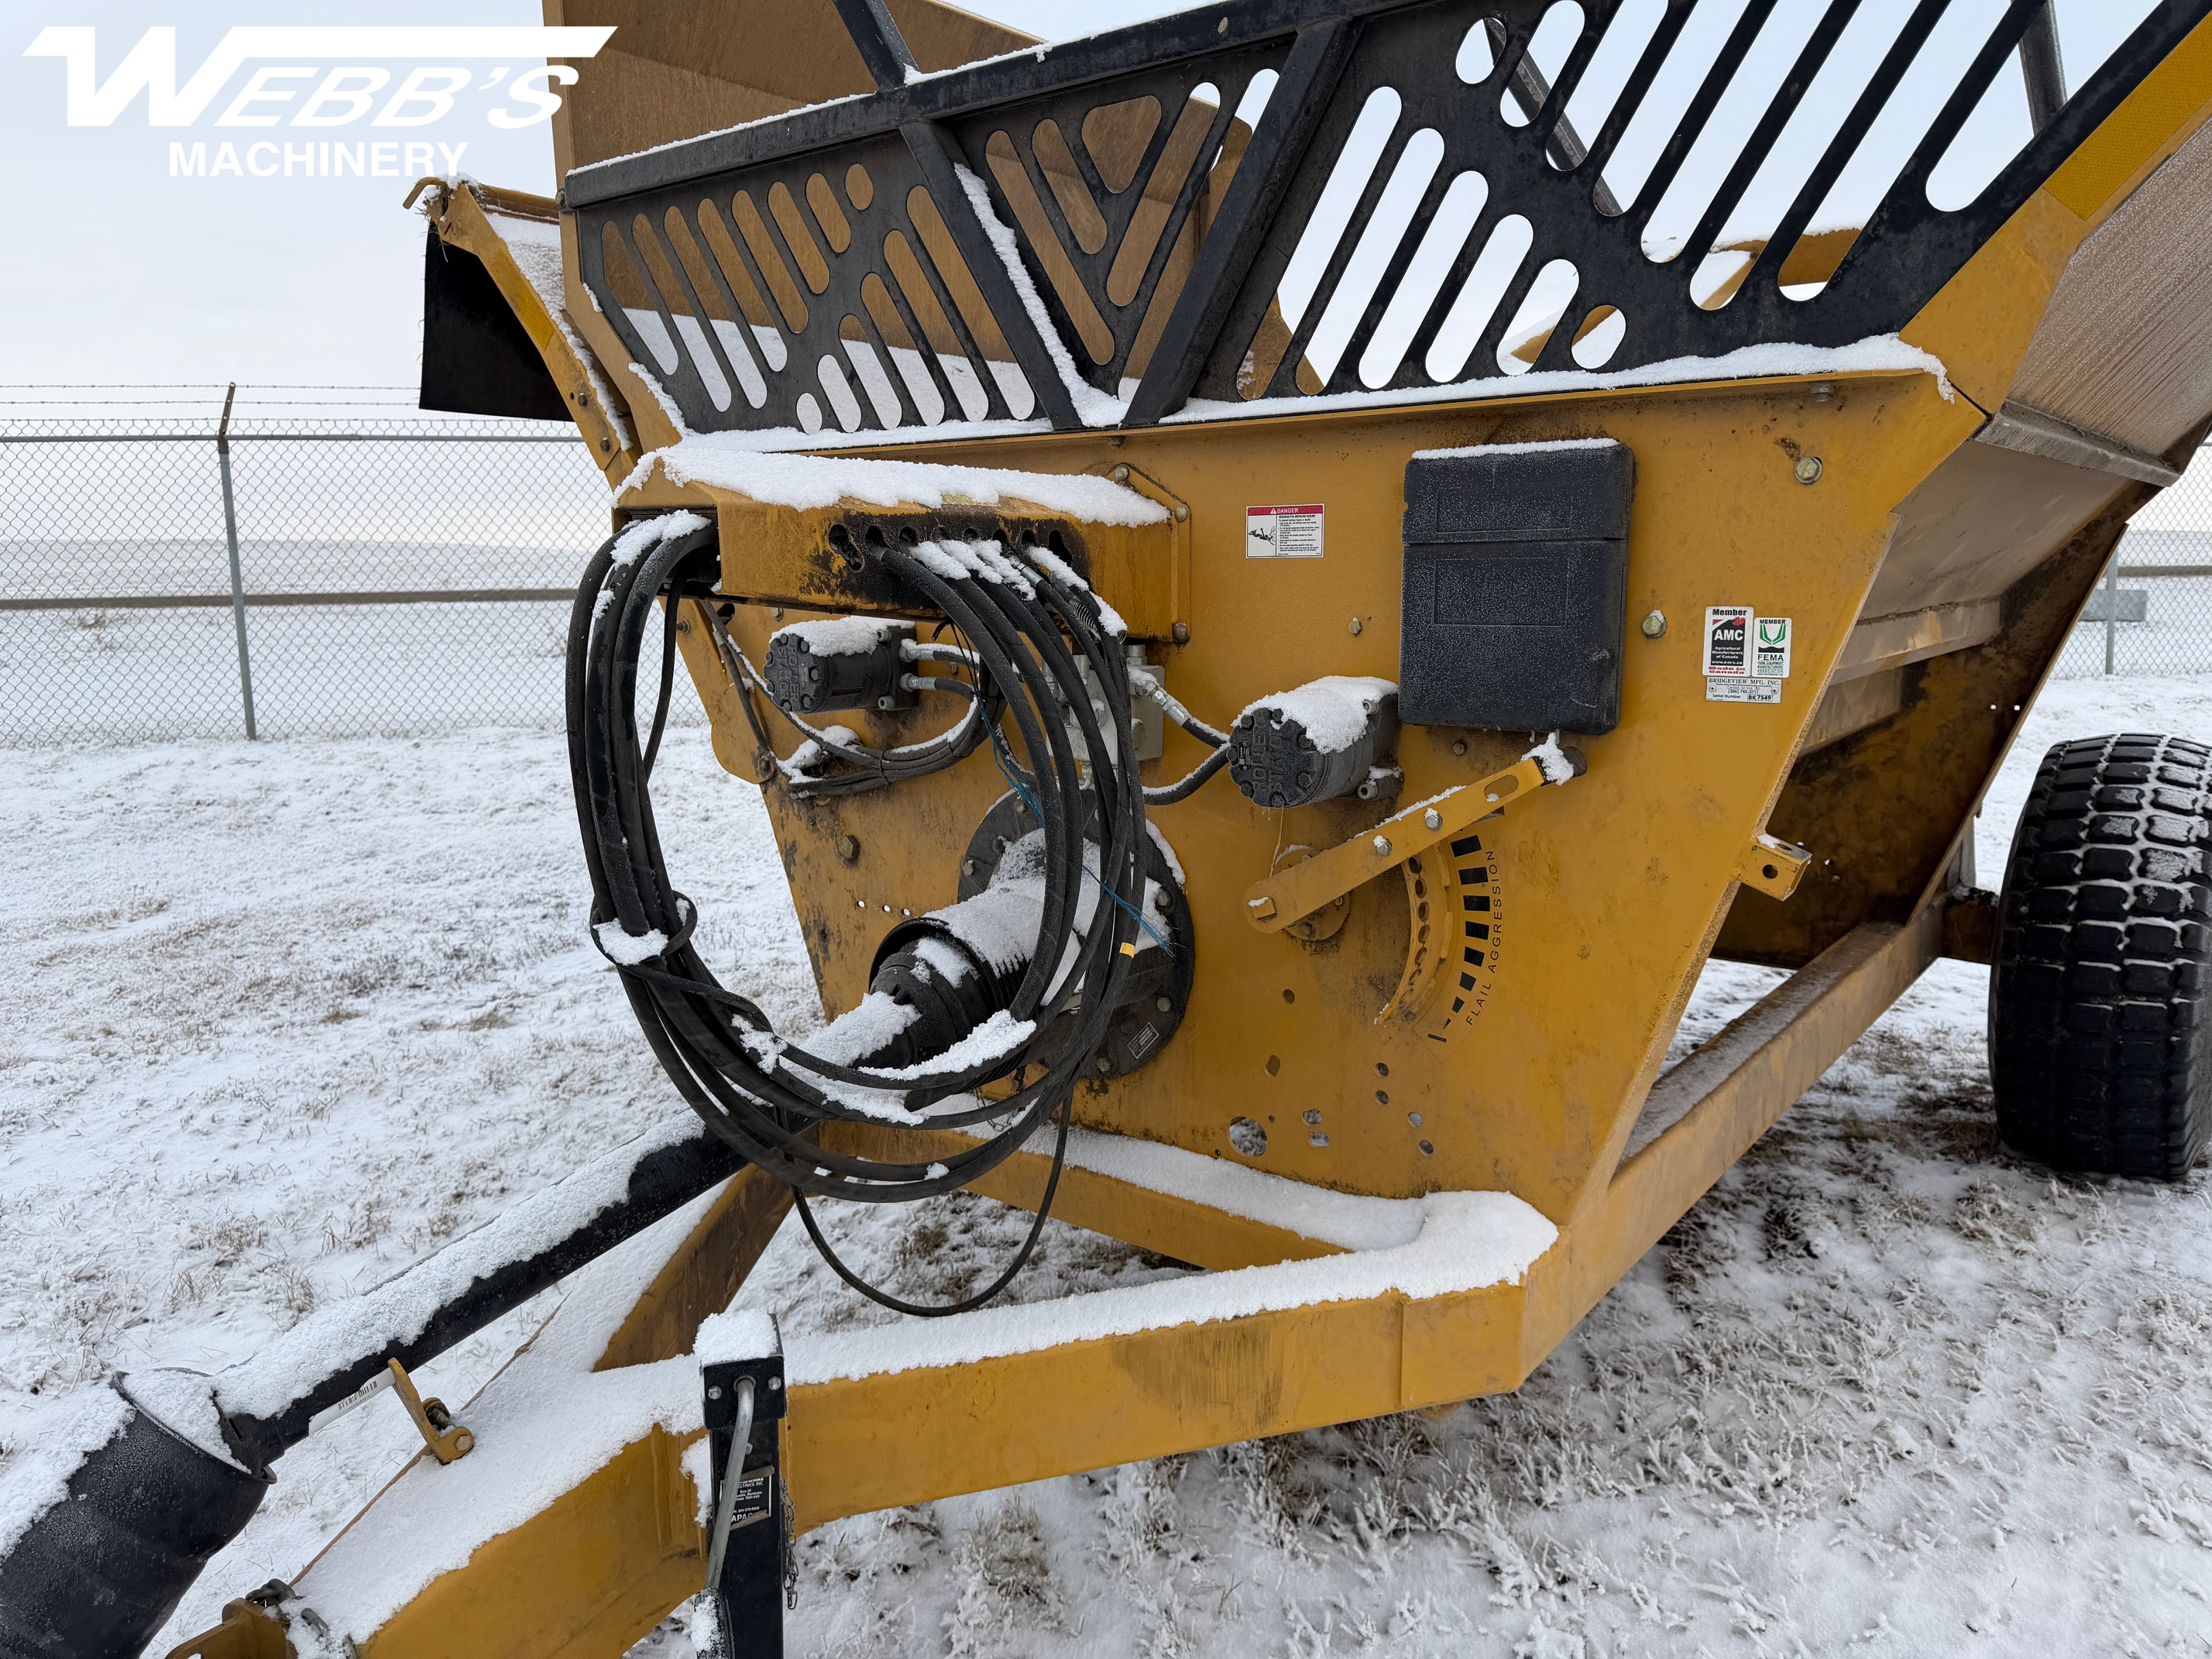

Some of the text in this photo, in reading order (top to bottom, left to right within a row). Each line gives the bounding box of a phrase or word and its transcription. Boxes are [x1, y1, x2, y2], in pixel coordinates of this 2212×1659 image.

[1714, 629, 1743, 641] AMC
[788, 647, 799, 701] ROLLER
[1465, 850, 1503, 1025] FLAIL AGGRESSION
